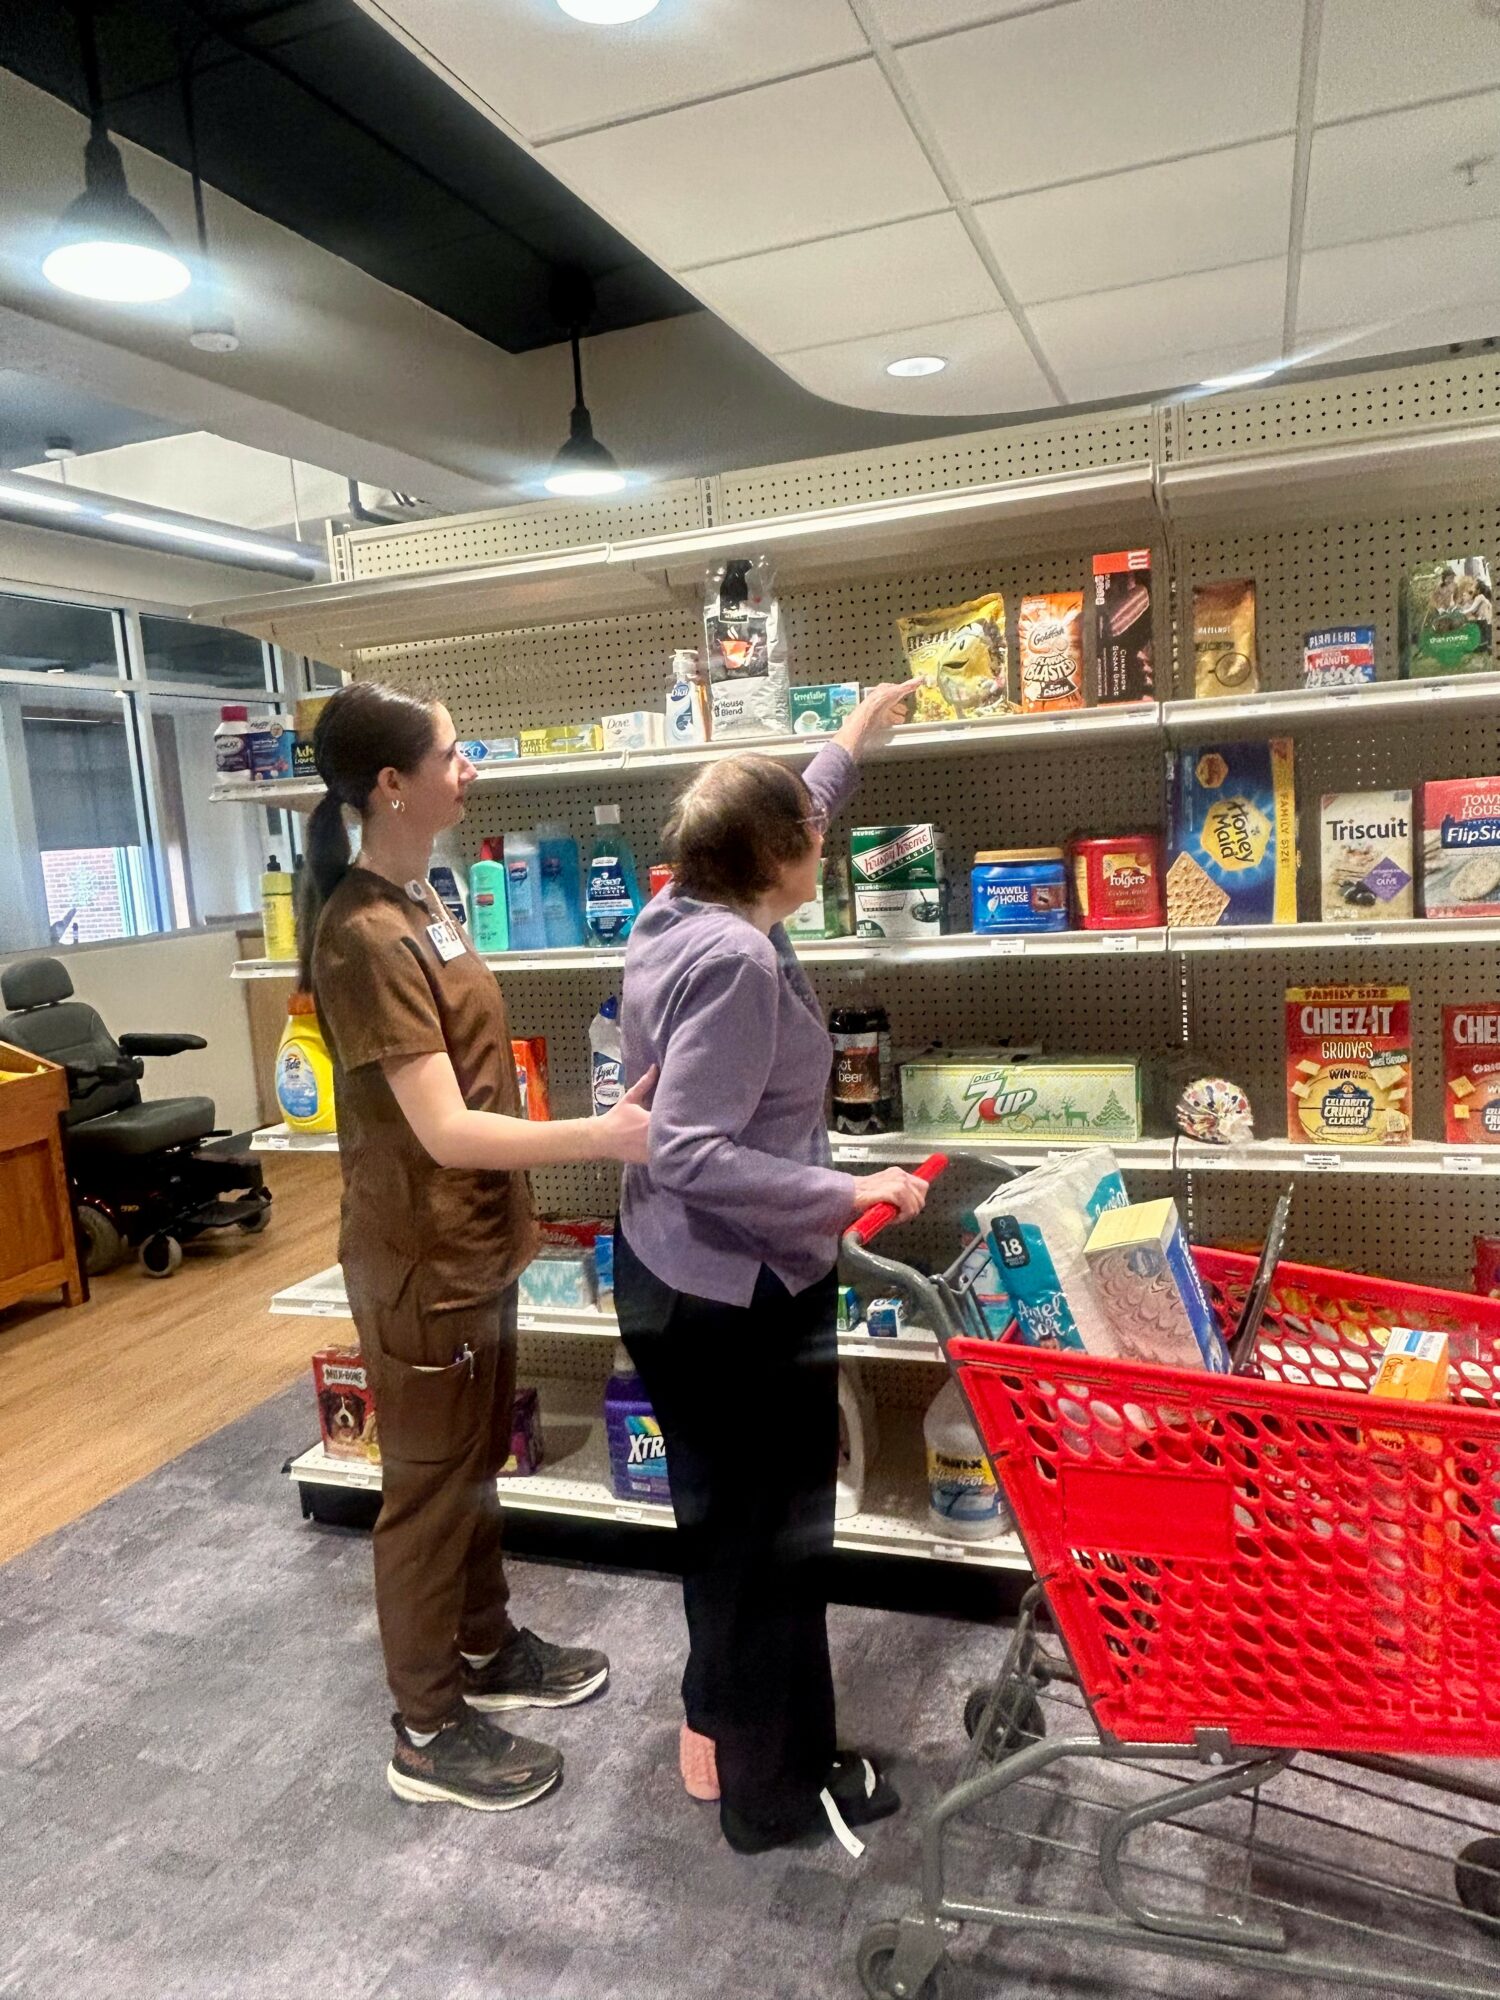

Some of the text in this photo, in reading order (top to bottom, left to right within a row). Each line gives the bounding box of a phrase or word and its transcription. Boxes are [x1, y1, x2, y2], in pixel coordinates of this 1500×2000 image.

[1033, 627, 1065, 646] Goldfish
[1024, 659, 1077, 682] BLASTED
[721, 700, 745, 708] House
[721, 707, 743, 716] Blend
[607, 719, 630, 729] Dove
[294, 745, 316, 758] Adv
[1461, 805, 1500, 820] HOUS
[1226, 801, 1255, 864] Honey
[1326, 816, 1409, 841] Triscuit
[1446, 825, 1500, 844] FlipSi
[1212, 813, 1235, 860] Maid
[1109, 869, 1146, 888] Folgers
[987, 885, 1029, 896] MAXWELL
[1000, 894, 1030, 905] HOUSE
[1304, 988, 1388, 1001] FAMILY SIZE
[1452, 1014, 1500, 1044] CHE
[838, 1059, 852, 1071] ot
[596, 1064, 617, 1081] Lysol
[838, 1071, 863, 1083] beer
[972, 1072, 999, 1083] DIET
[1329, 1068, 1351, 1080] WIN
[1325, 1098, 1371, 1106] CELEBRITY
[1323, 1106, 1369, 1118] CRUNCH
[1328, 1117, 1364, 1125] CLASSIC
[1001, 1238, 1023, 1257] 18
[1018, 1292, 1067, 1321] Angel
[1028, 1318, 1065, 1341] Soft
